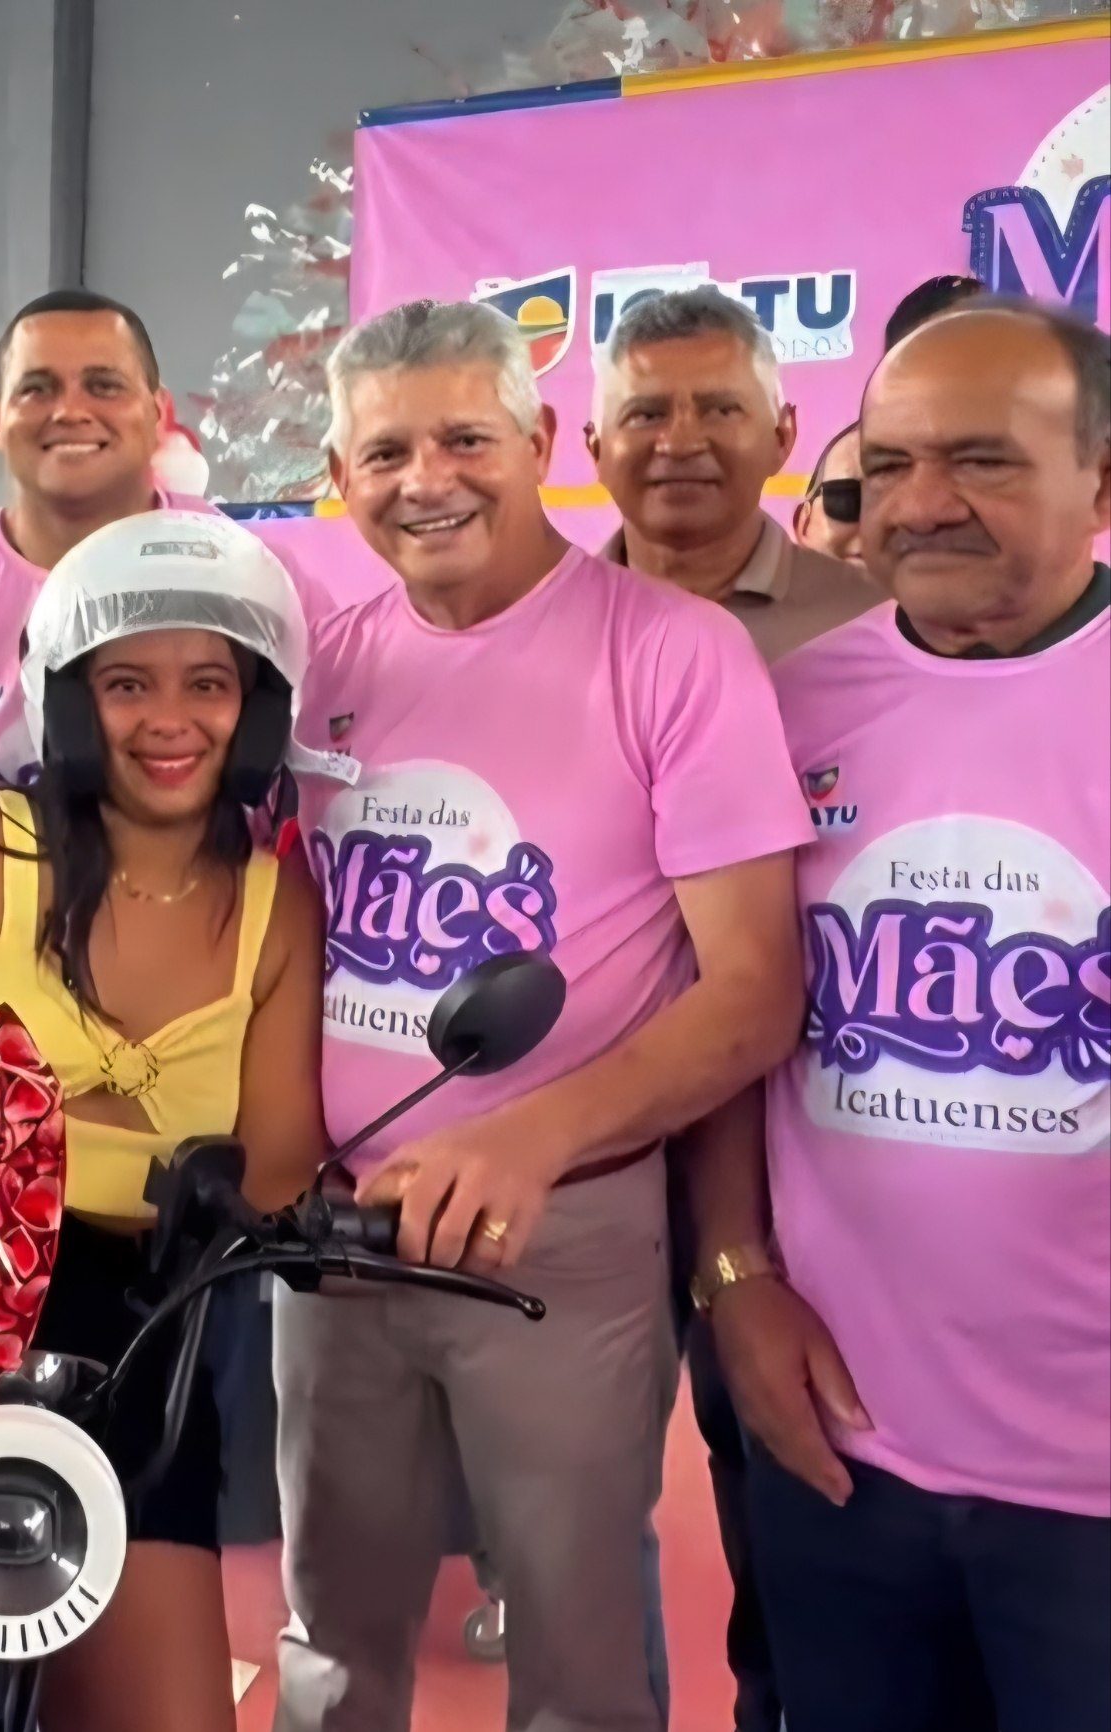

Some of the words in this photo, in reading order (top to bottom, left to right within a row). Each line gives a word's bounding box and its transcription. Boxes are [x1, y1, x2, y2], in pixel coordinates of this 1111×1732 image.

[594, 275, 851, 344] ITU
[361, 796, 421, 825] Festa
[428, 798, 471, 827] das
[890, 861, 970, 891] Festa
[835, 1073, 1080, 1135] Icatuenses
